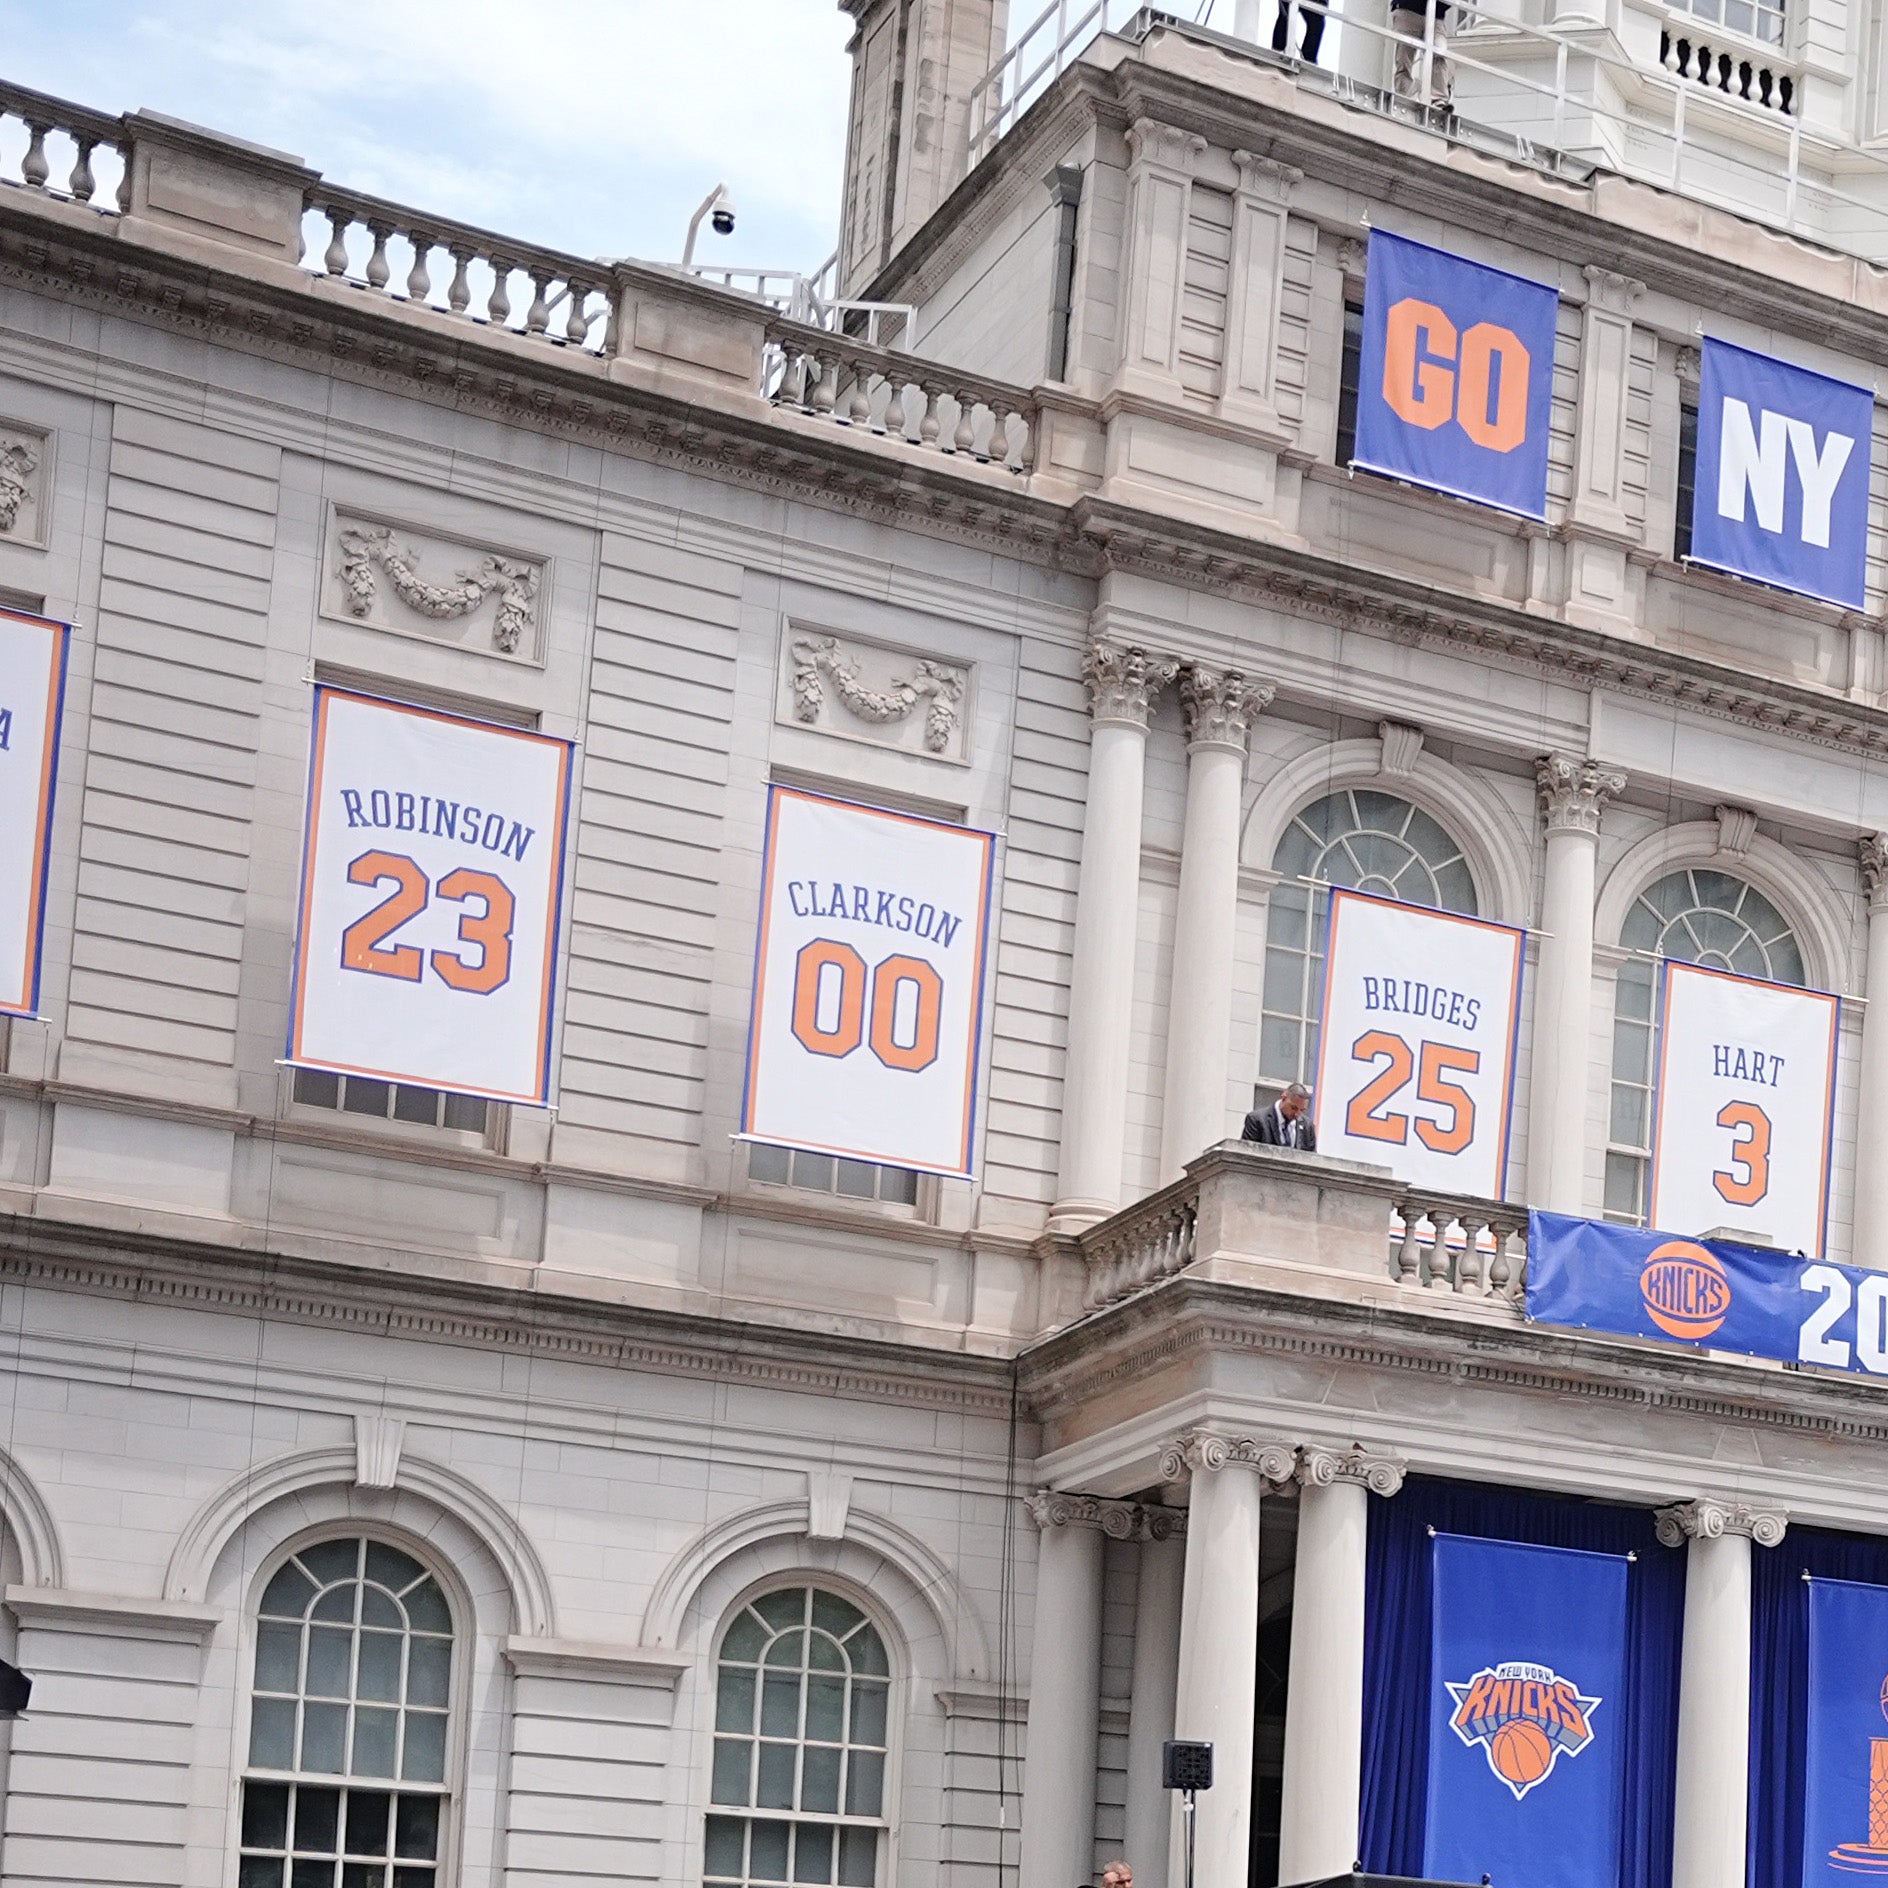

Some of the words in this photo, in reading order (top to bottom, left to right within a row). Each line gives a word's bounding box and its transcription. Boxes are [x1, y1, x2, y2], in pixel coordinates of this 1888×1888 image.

[1382, 298, 1530, 453] GO
[1718, 397, 1855, 548] NY
[340, 788, 536, 863] ROBINSON
[340, 848, 517, 997] 23
[787, 881, 962, 951] CLARKSON
[790, 937, 944, 1073] 00
[1363, 976, 1482, 1031] BRIDGES
[1344, 1029, 1481, 1157] 25
[1712, 1044, 1786, 1088] HART
[1712, 1100, 1771, 1207] 3
[1648, 1266, 1723, 1314] KNICKS
[1454, 1673, 1589, 1739] KNICKS
[1499, 1665, 1522, 1678] NEW
[1524, 1667, 1553, 1683] YORK
